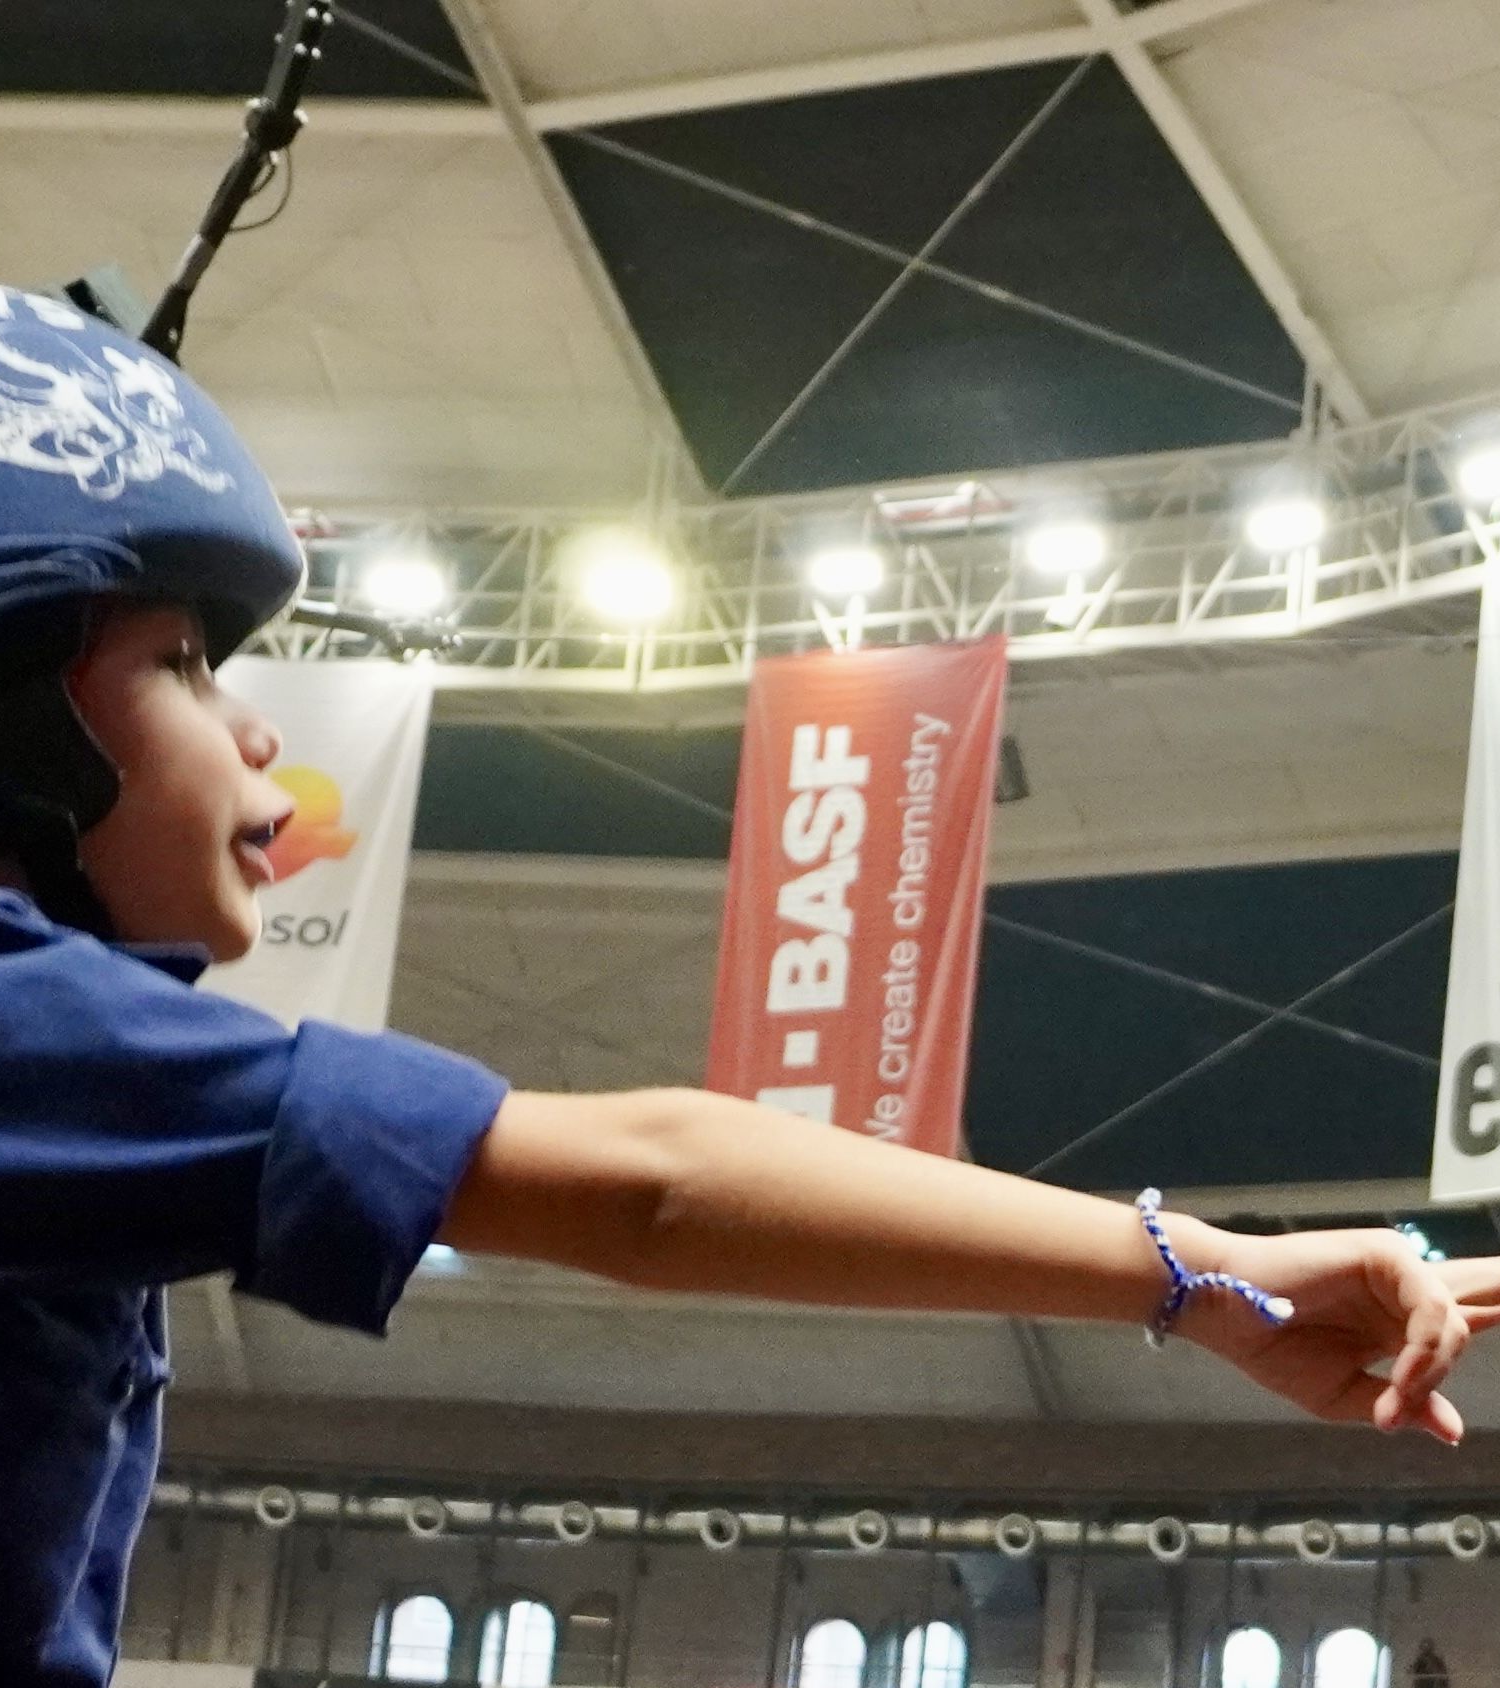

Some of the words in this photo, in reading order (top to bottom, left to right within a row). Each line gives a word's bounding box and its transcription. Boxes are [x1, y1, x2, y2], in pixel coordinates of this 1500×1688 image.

[768, 725, 871, 1013] BASF
[887, 712, 952, 930] chemistry
[264, 909, 350, 948] sol
[877, 940, 920, 1083] create
